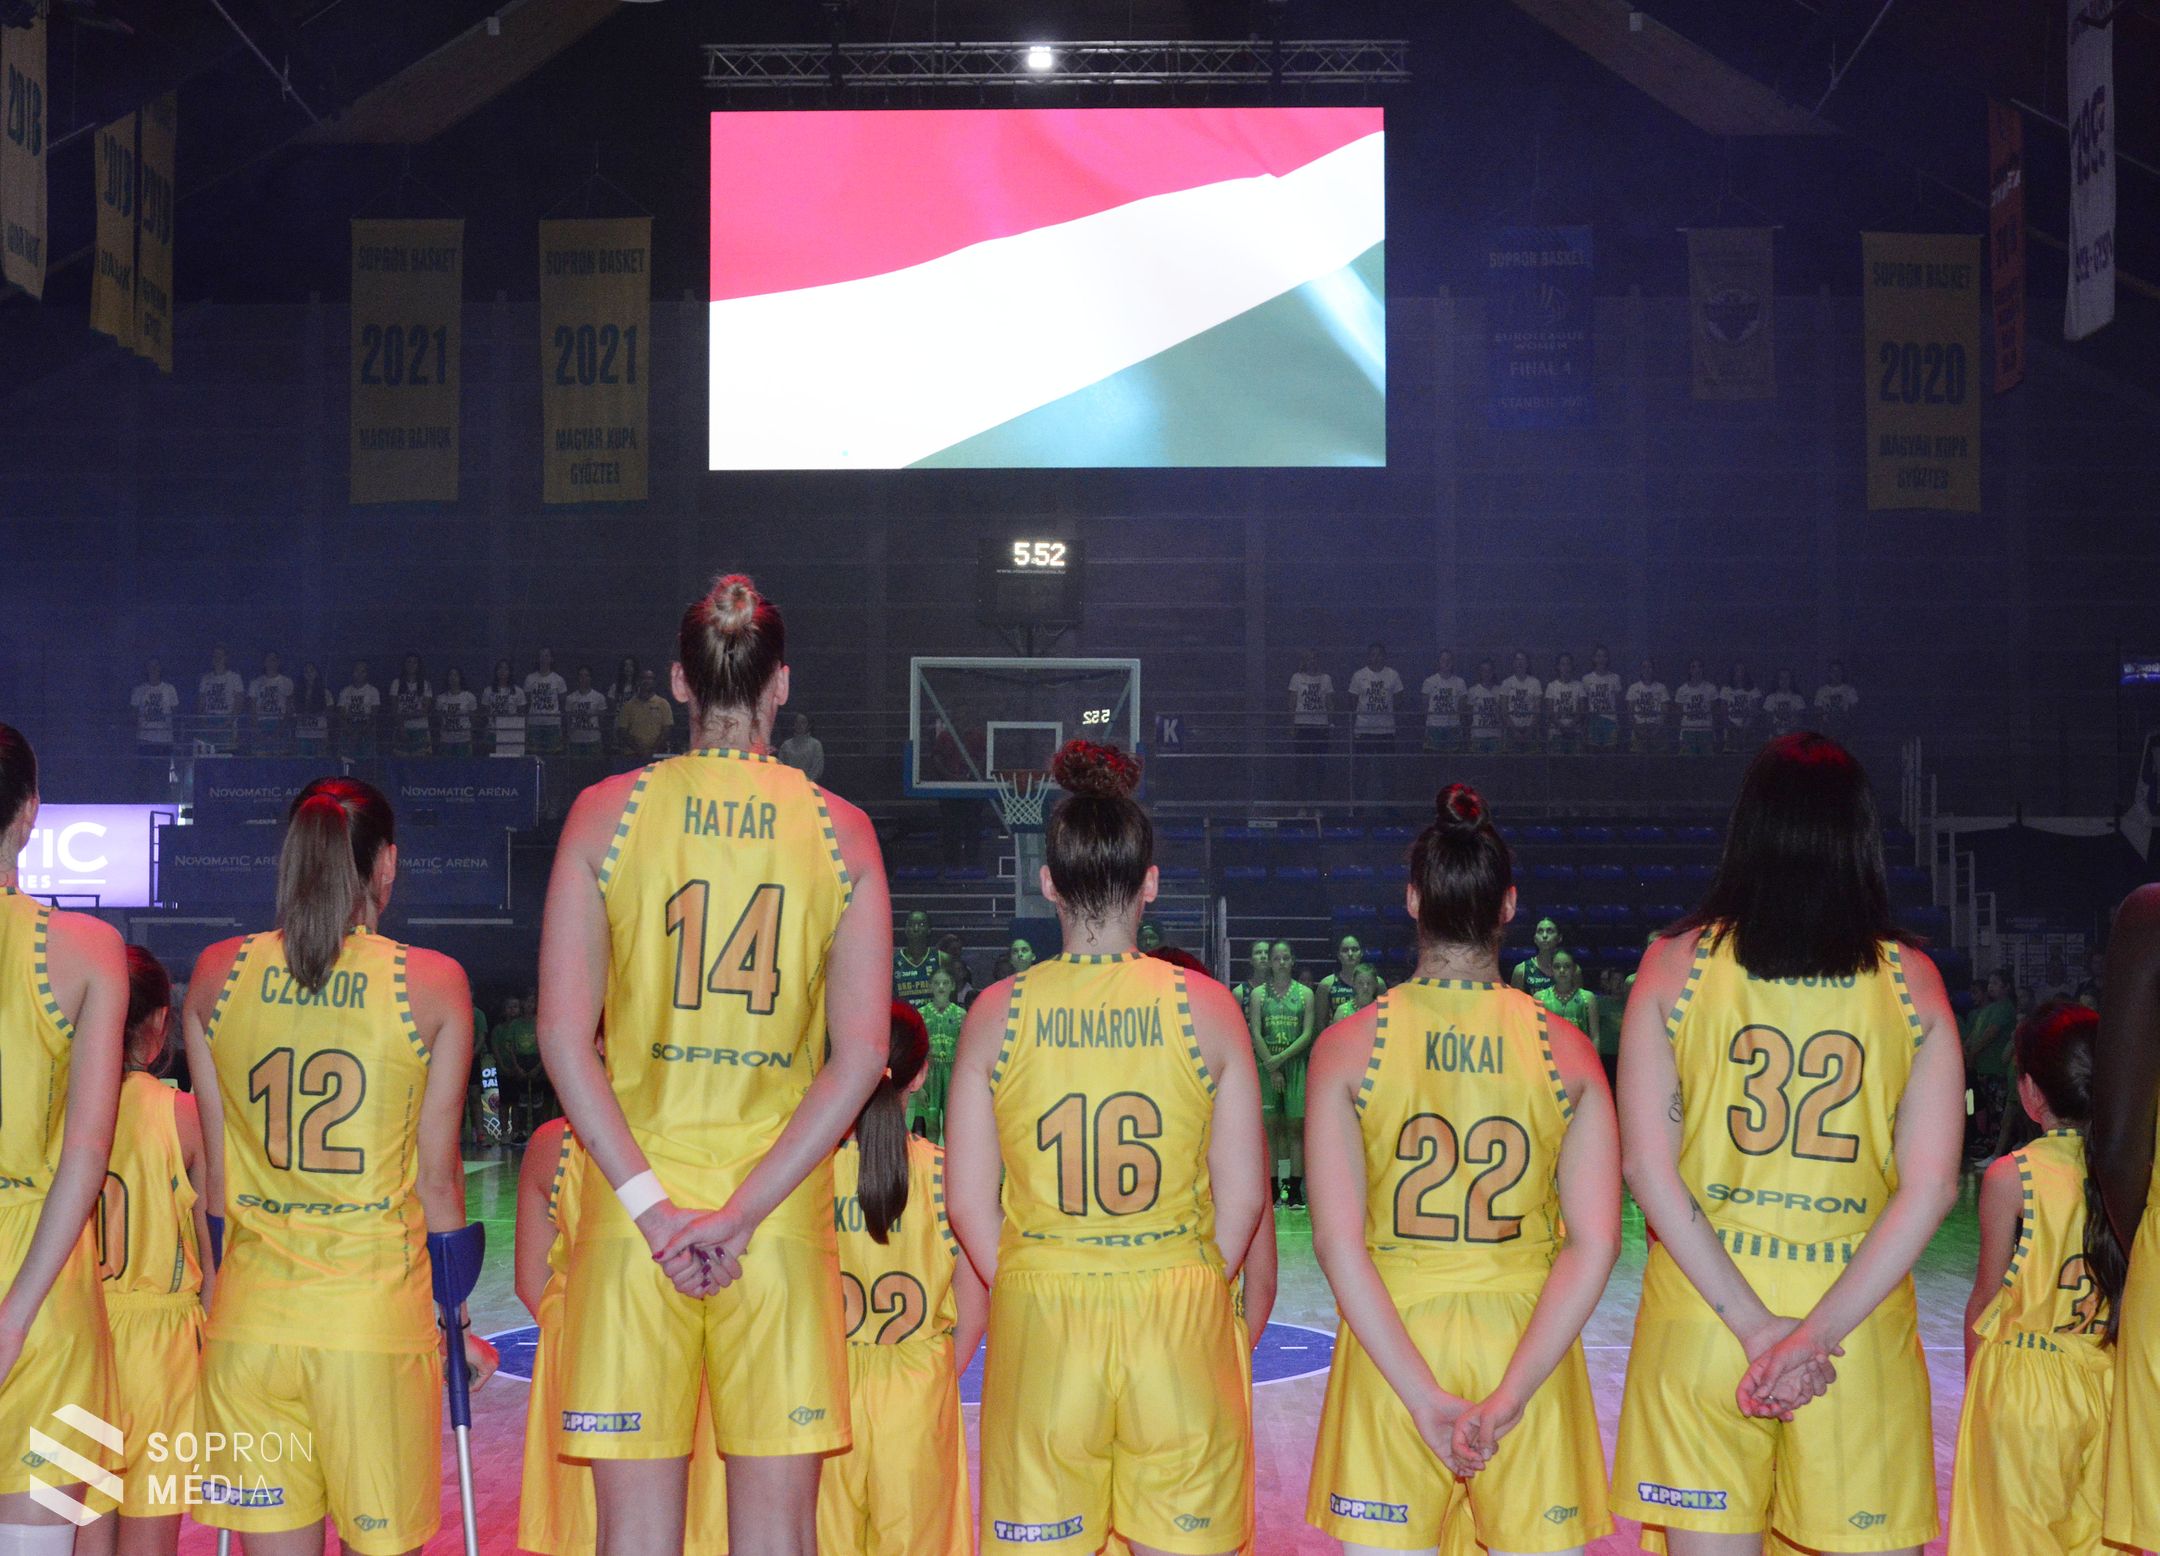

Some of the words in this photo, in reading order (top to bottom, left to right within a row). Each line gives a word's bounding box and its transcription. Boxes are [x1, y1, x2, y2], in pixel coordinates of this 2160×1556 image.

[411, 247, 456, 272] BASKET
[599, 248, 645, 274] BASKET
[1926, 264, 1971, 289] BASKET
[361, 323, 447, 387] 2021
[554, 323, 638, 386] 2021
[1510, 361, 1556, 376] FINAL
[1879, 341, 1966, 405] 2020
[555, 427, 603, 450] MAGYAR
[606, 427, 637, 449] KUPA
[1935, 435, 1968, 458] KUPA
[1163, 719, 1179, 743] K
[683, 794, 778, 840] HATÁR
[665, 879, 785, 1016] 14
[1036, 998, 1164, 1048] MOLNÁROVÁ
[651, 1042, 793, 1069] SOPRON
[1425, 1024, 1504, 1074] KÓKAI
[249, 1046, 367, 1175] 12
[1727, 1023, 1865, 1163] 32
[1037, 1090, 1163, 1217] 16
[1393, 1112, 1530, 1243] 22
[1706, 1183, 1868, 1214] SOPRON
[237, 1194, 390, 1215] SOPRON
